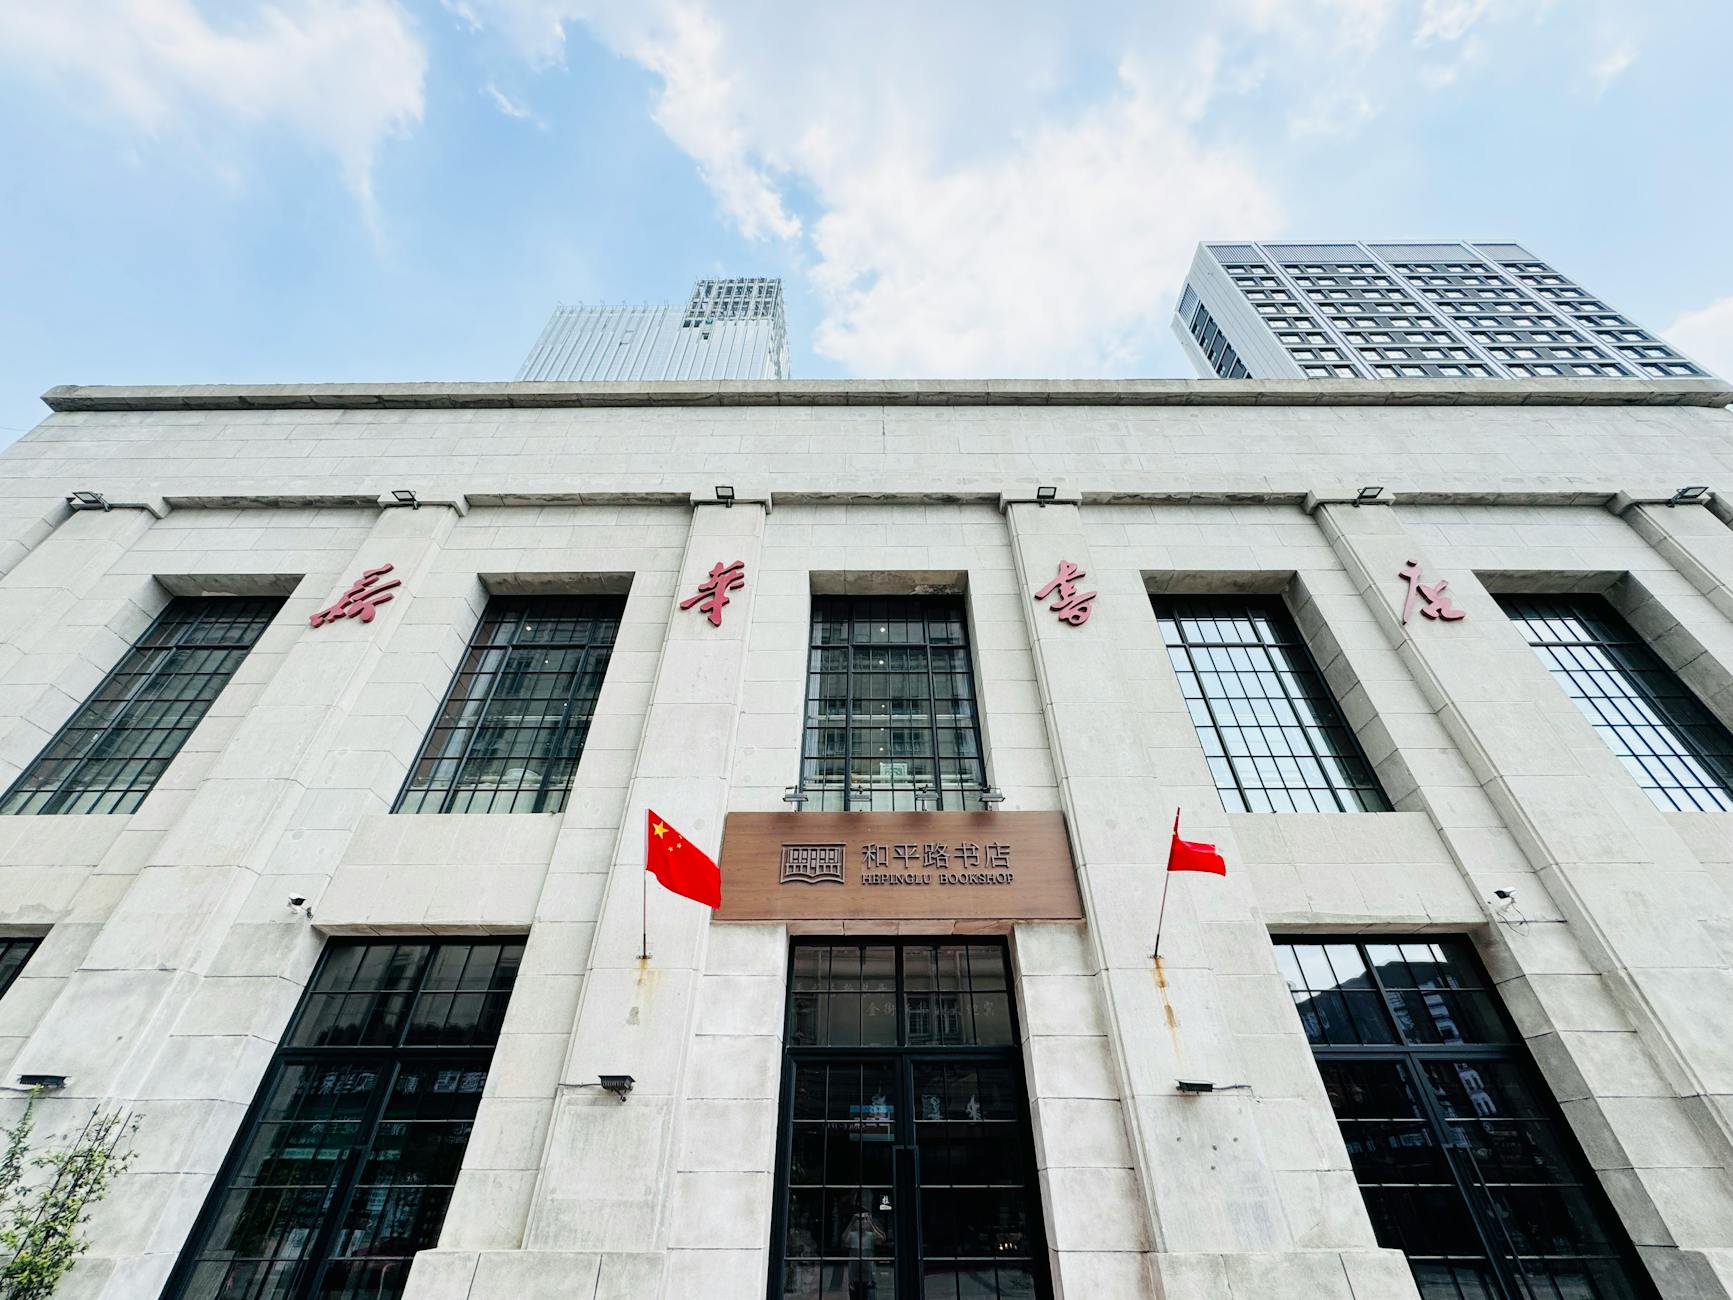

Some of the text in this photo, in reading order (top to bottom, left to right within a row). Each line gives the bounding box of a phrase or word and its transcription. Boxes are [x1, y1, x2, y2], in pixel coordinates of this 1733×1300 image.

[861, 840, 1011, 869] 和平路书店
[861, 872, 1014, 885] HEPINGLU BOOKSHOP
